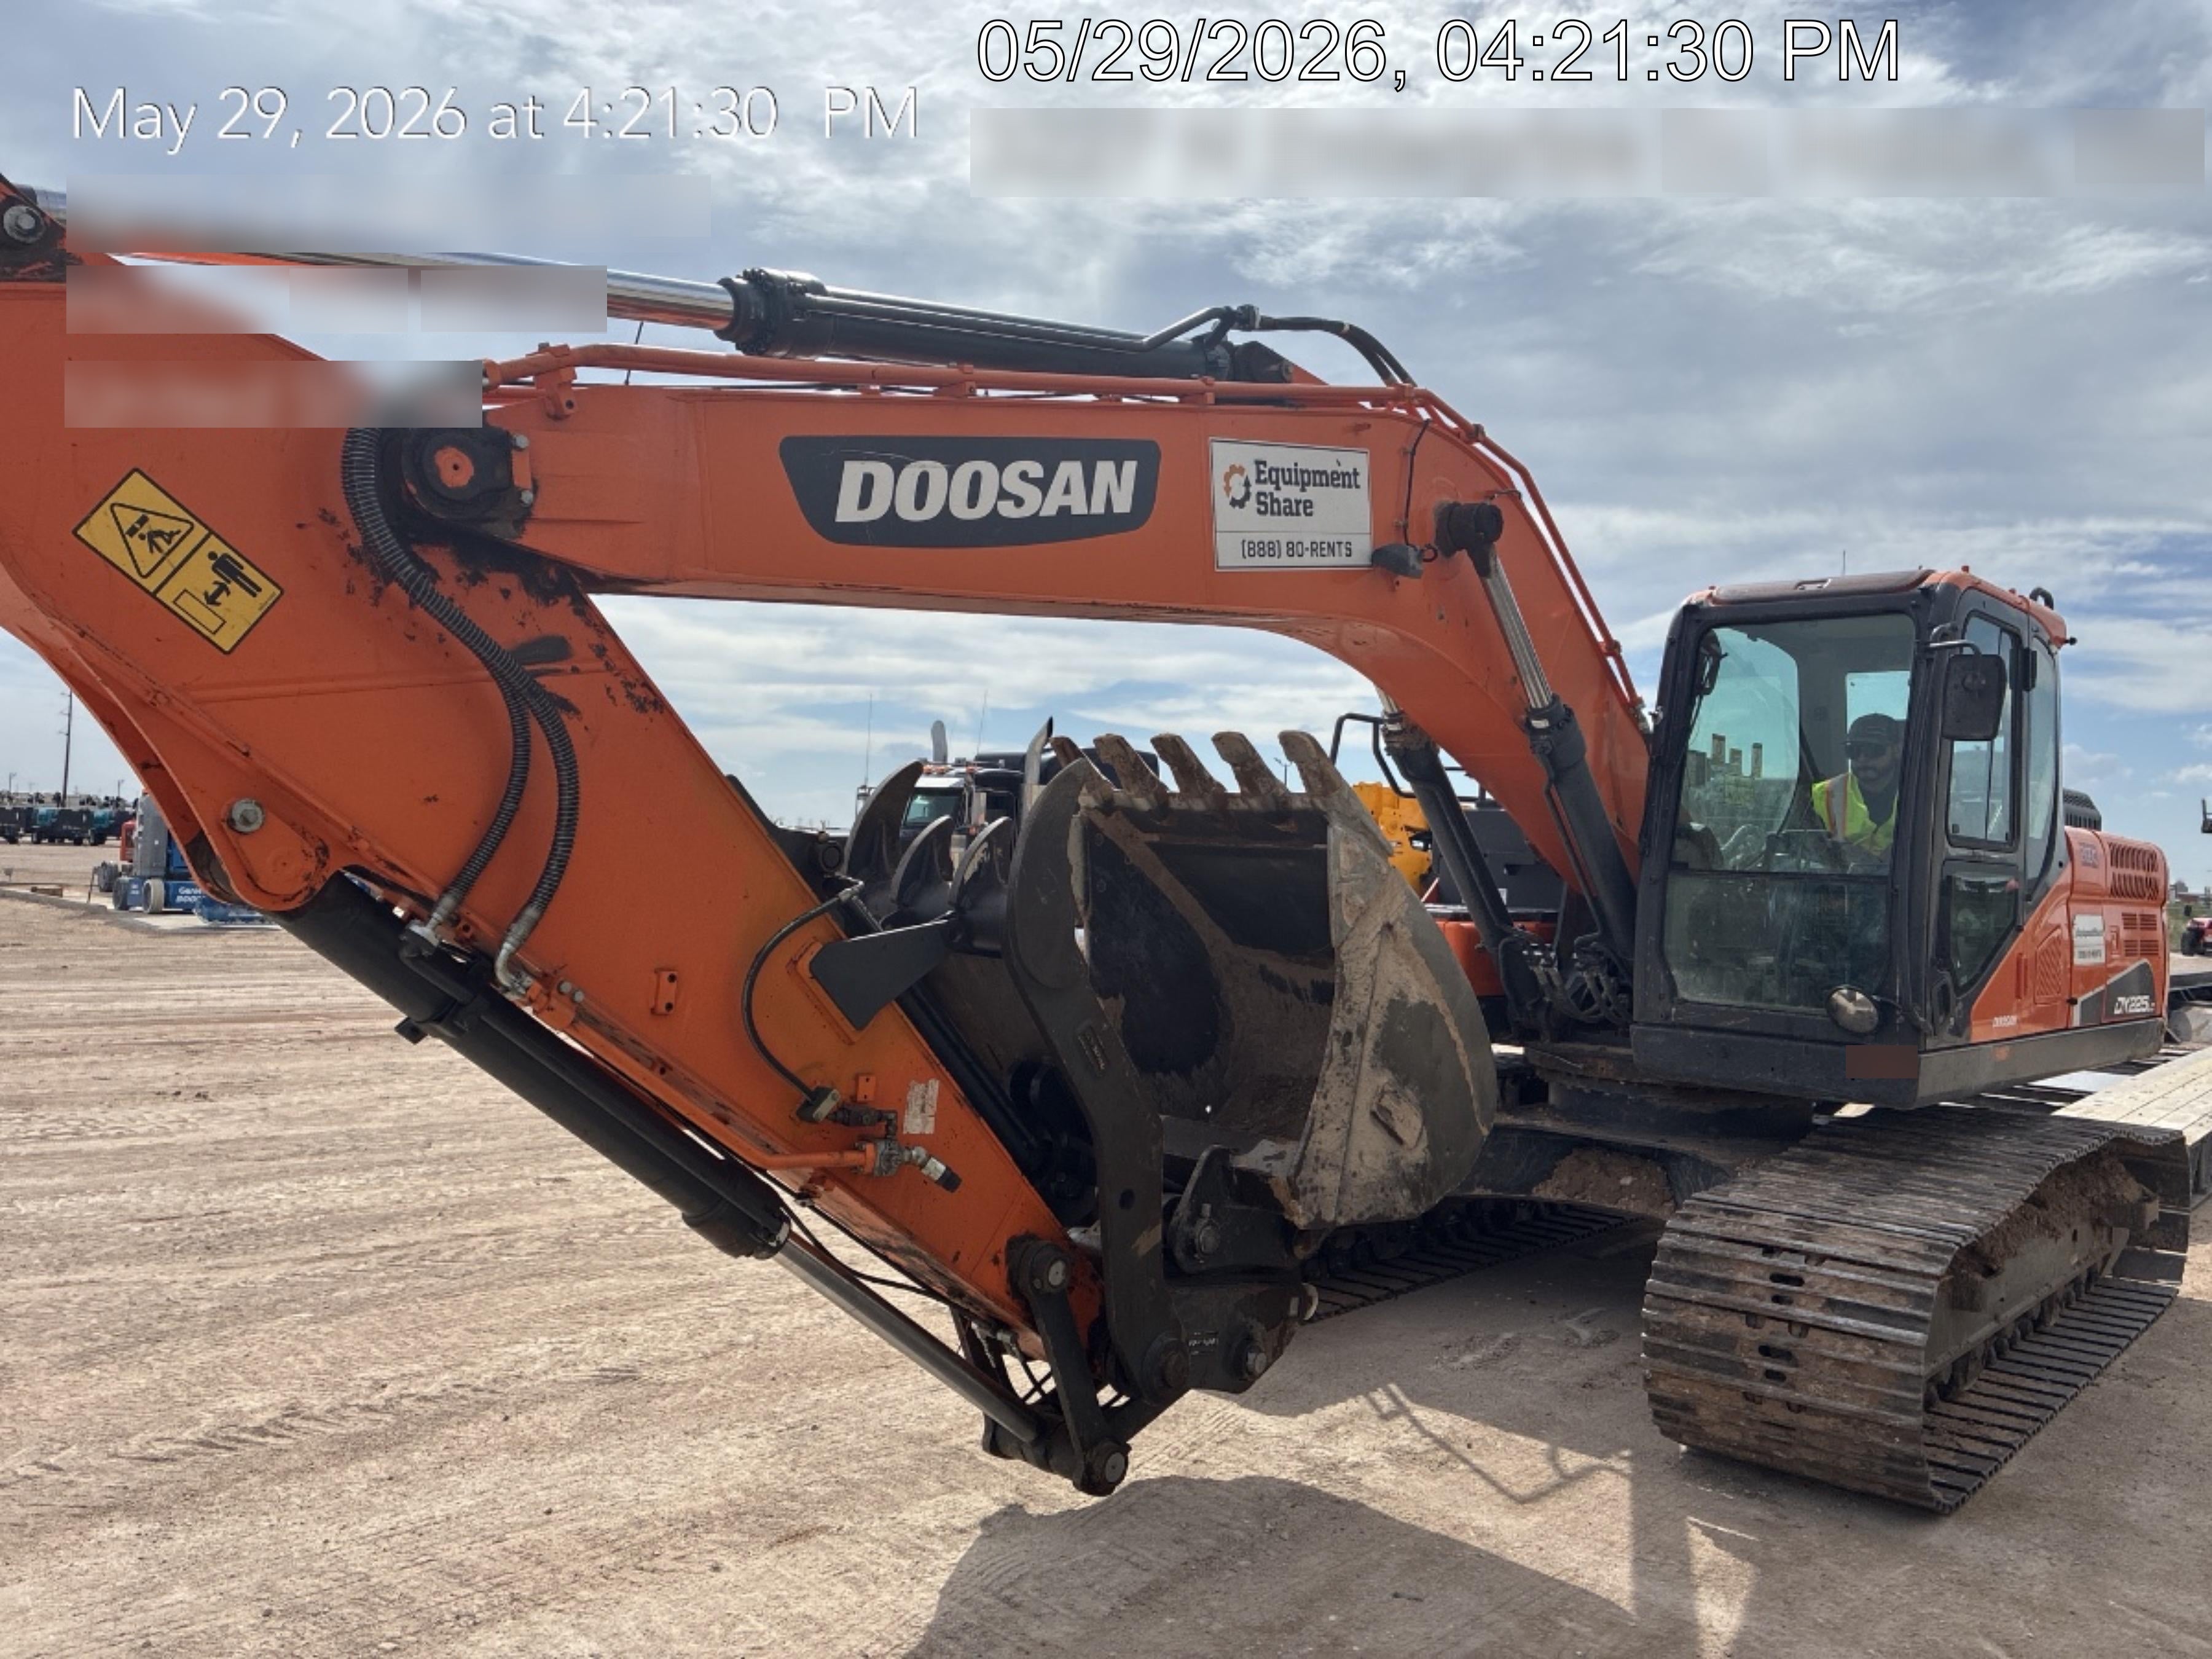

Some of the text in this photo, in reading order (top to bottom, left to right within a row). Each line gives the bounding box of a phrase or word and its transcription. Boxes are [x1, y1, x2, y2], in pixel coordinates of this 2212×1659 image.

[1254, 460, 1360, 492] Equipment
[834, 460, 1138, 523] DOOSAN
[1256, 491, 1314, 517] Share
[1242, 539, 1352, 560] (888) 80-RENTS
